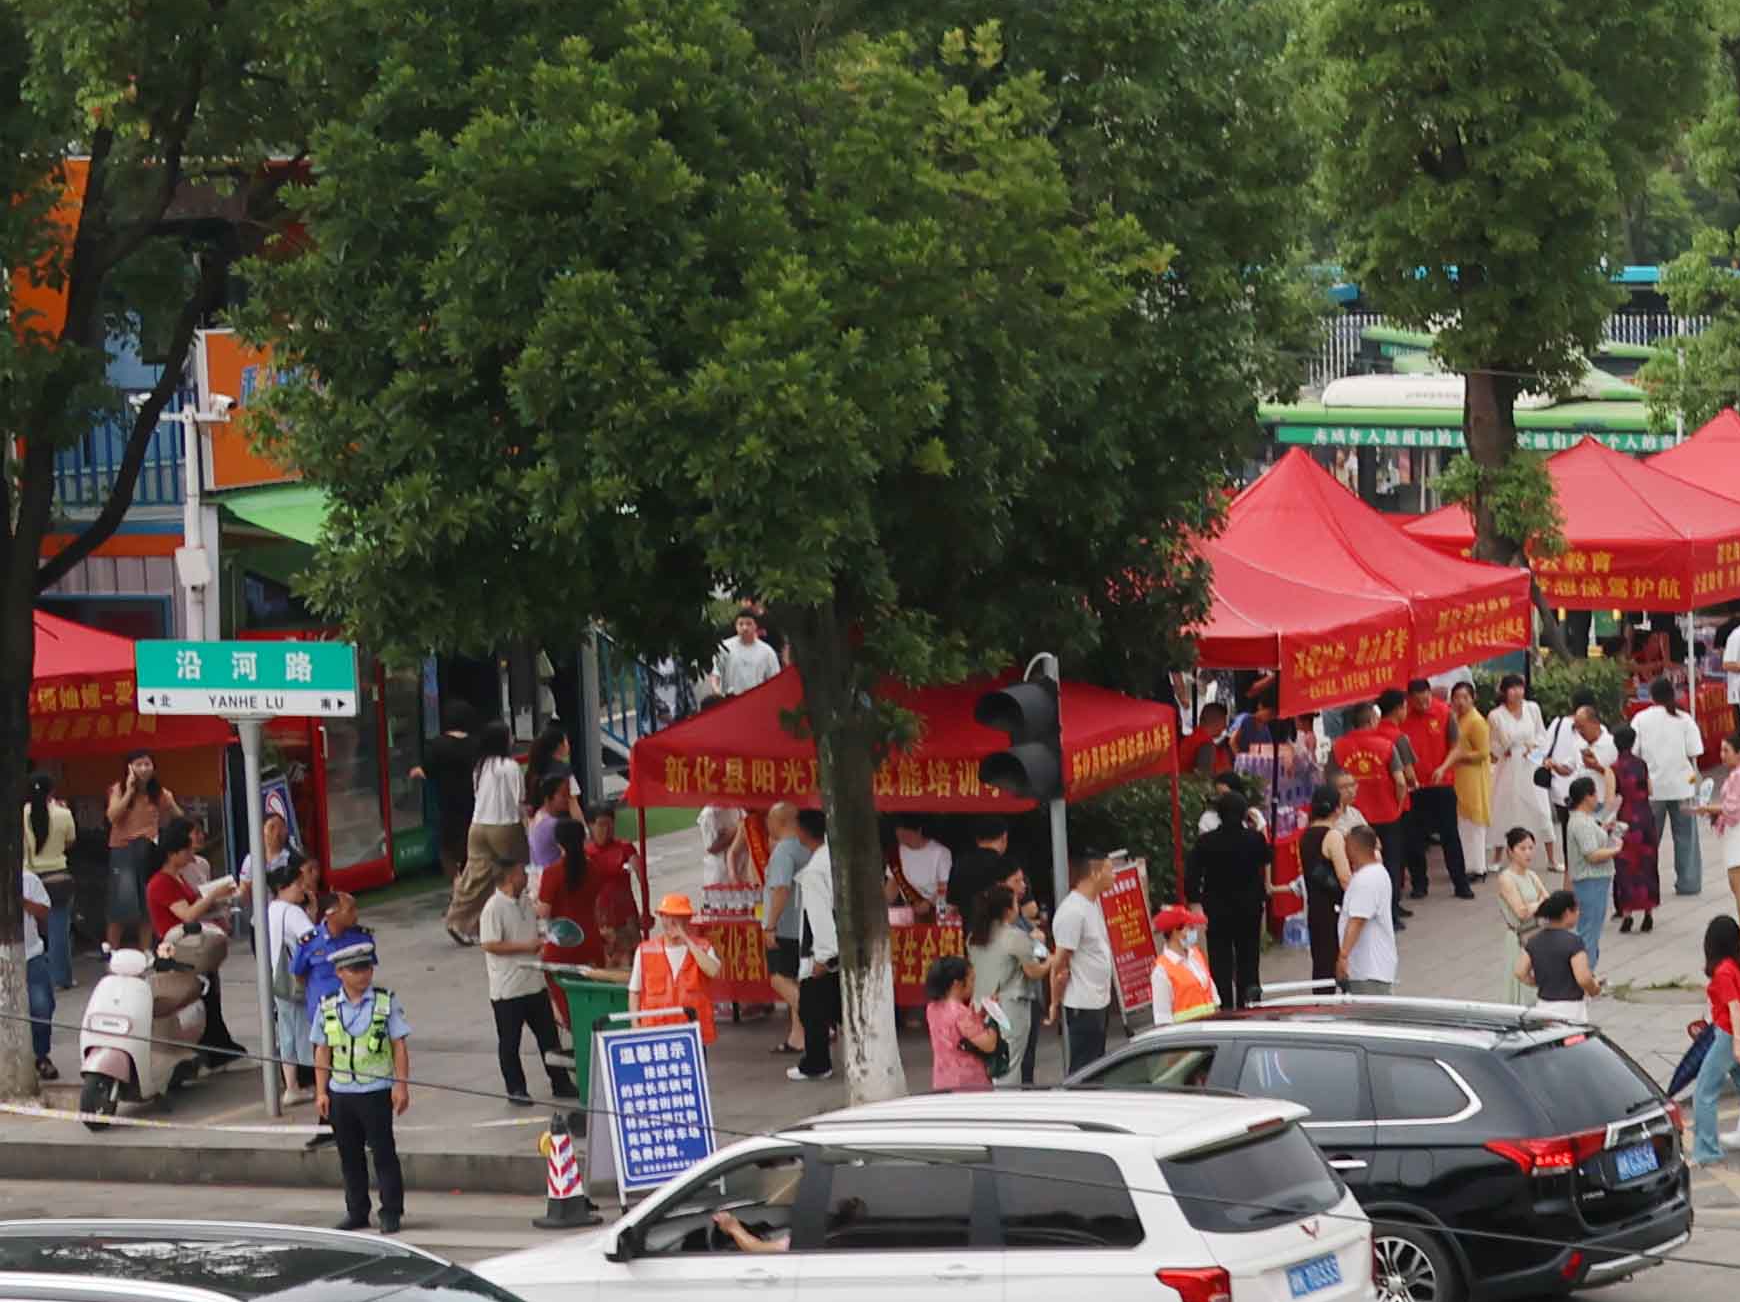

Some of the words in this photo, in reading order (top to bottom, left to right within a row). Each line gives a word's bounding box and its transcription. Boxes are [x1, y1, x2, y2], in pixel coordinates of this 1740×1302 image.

[175, 649, 313, 683] 沿河路
[160, 695, 170, 708] 北
[208, 694, 257, 709] YANHE
[265, 695, 285, 709] LU
[619, 1041, 686, 1065] 温馨提示
